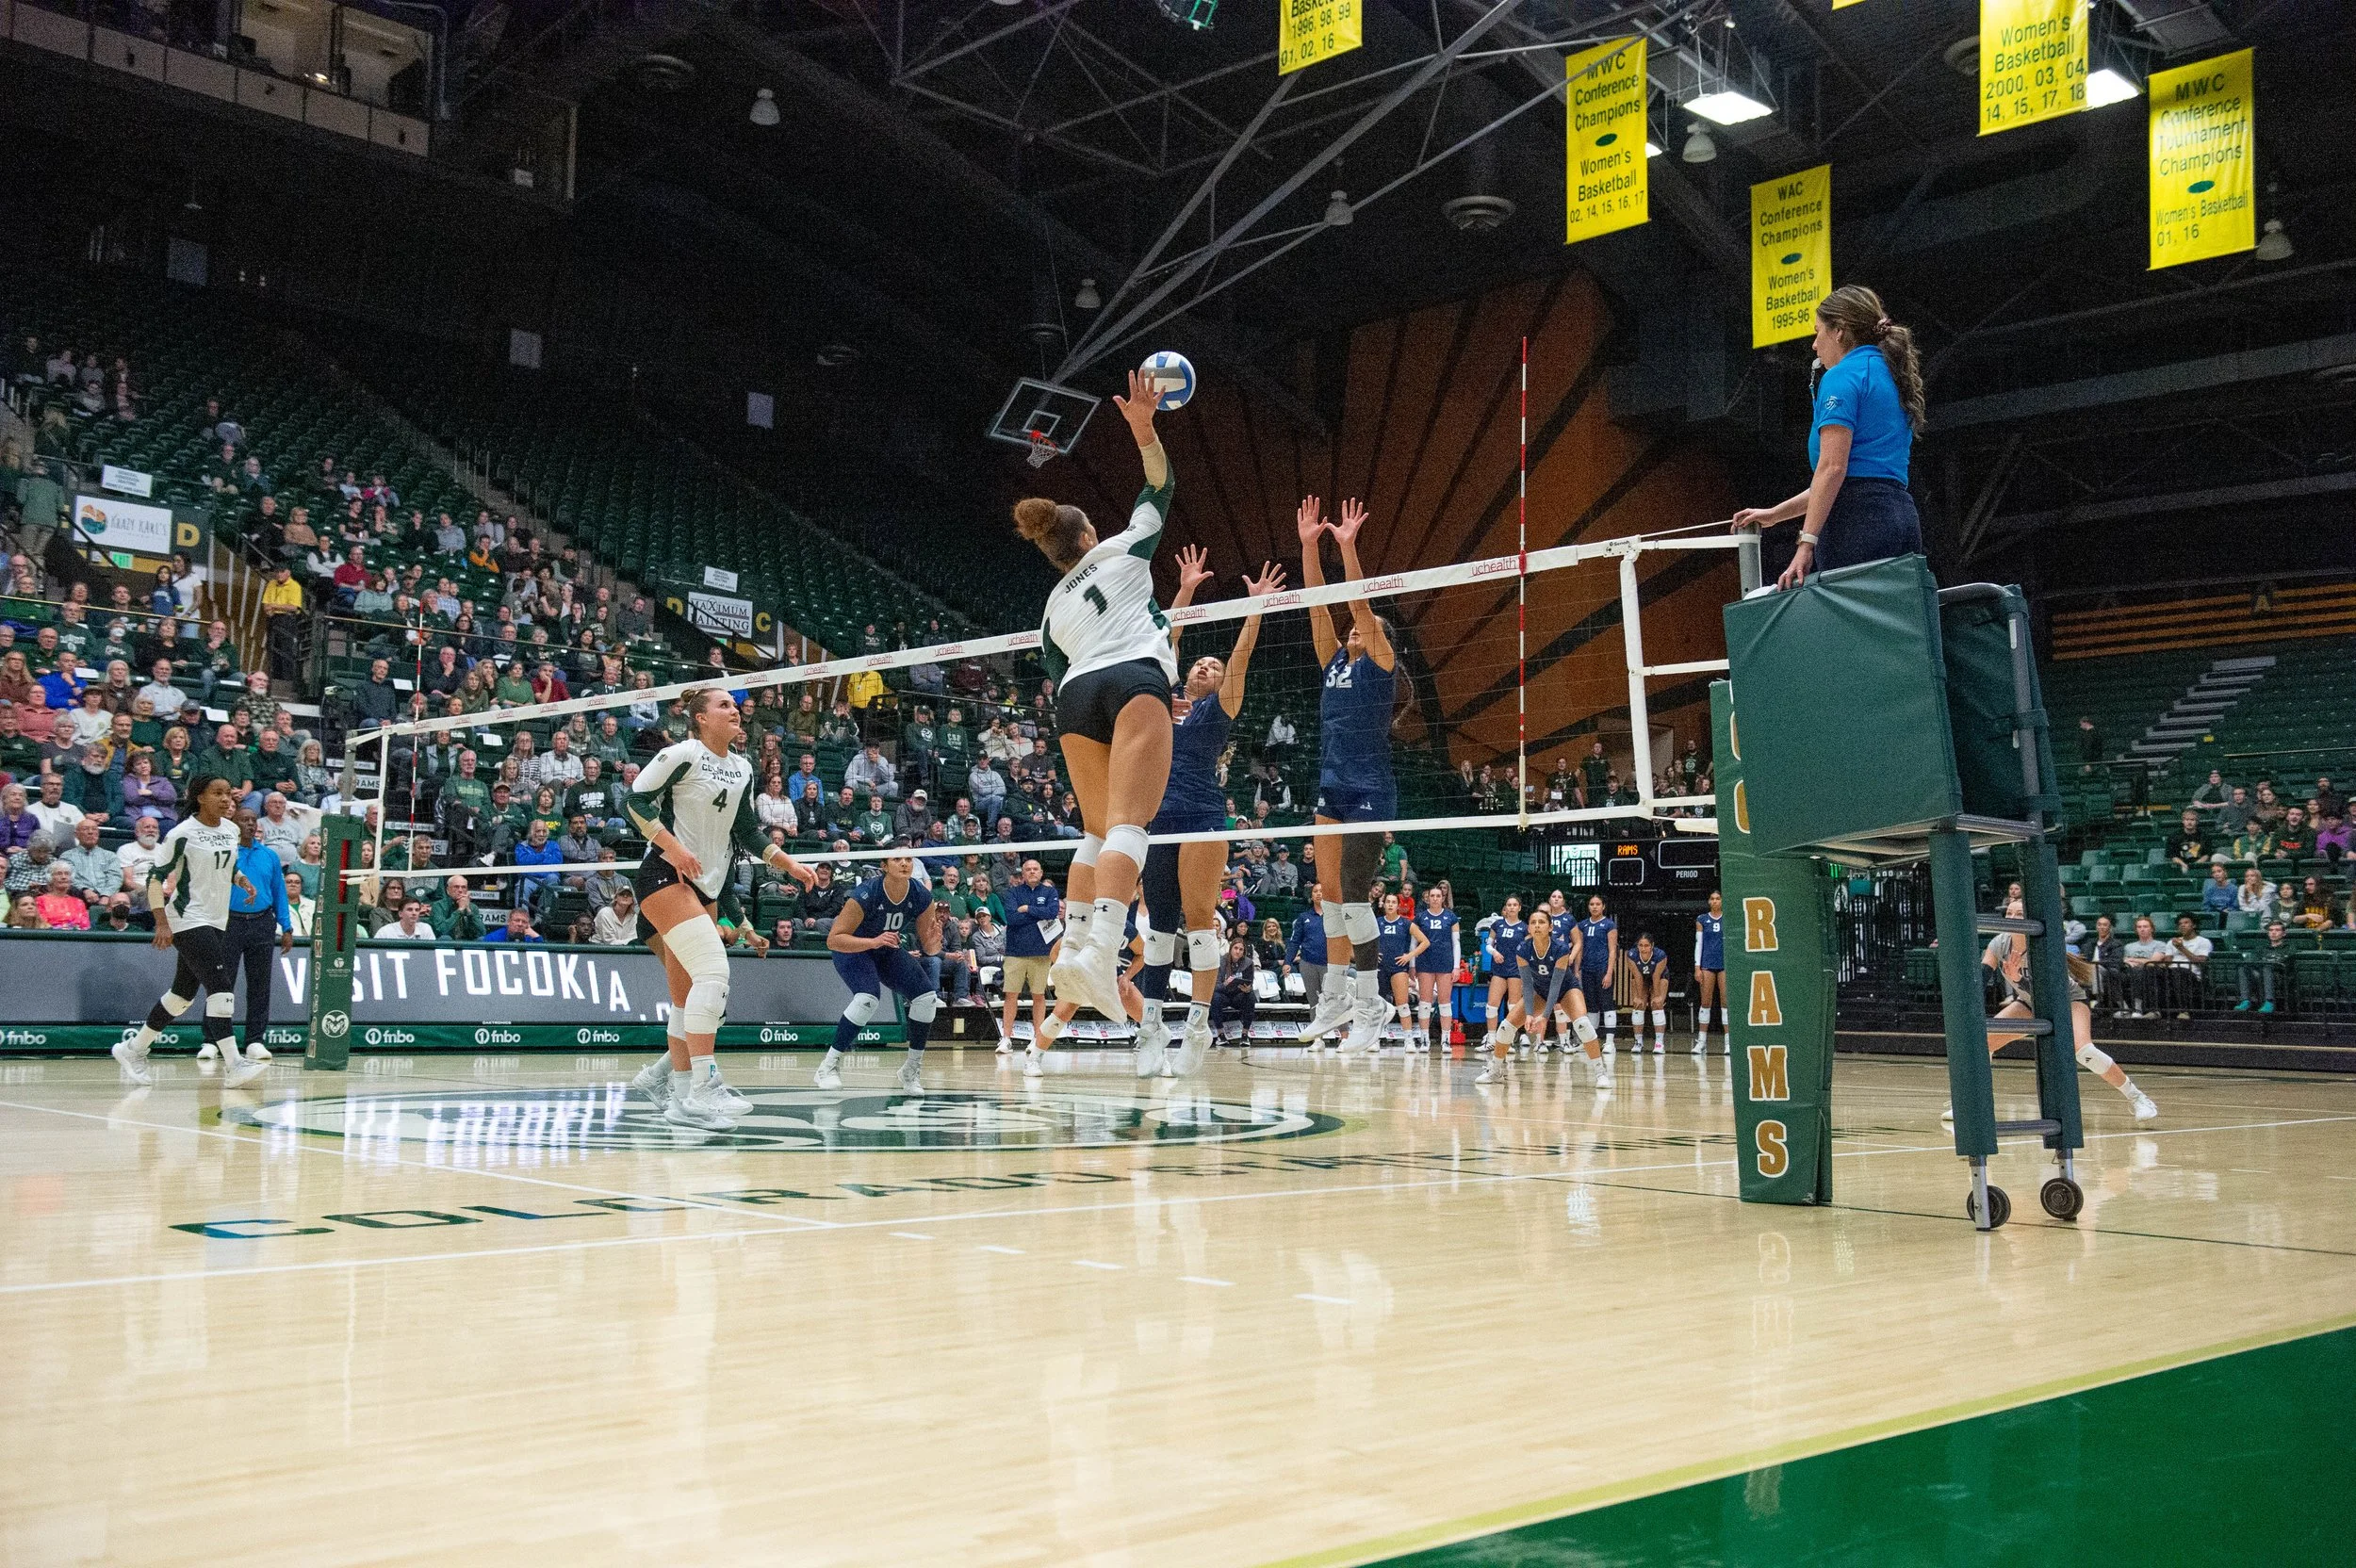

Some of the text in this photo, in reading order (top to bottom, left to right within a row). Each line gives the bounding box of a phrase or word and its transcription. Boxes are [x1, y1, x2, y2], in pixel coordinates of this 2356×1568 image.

[2001, 12, 2070, 47] Women's
[1322, 32, 1334, 52] 16
[1995, 34, 2074, 73] Basketball
[1575, 74, 1639, 106] Conference
[1986, 74, 2028, 100] 2000,
[2036, 66, 2058, 87] 03,
[2175, 73, 2225, 102] MWC
[1986, 82, 2085, 122] 14, 15, 17, 18
[2160, 95, 2241, 128] Conference
[1575, 99, 1641, 132] Champions
[2159, 118, 2248, 153] Tournament
[1580, 149, 1631, 176] Women's
[2160, 145, 2242, 176] Champions
[1579, 169, 1637, 202] Basketball
[1777, 181, 1803, 202] WAC
[1635, 190, 1644, 205] 17
[1760, 200, 1823, 227] Conference
[2155, 189, 2249, 227] Women's Basketball
[1761, 220, 1823, 247] Champions
[2184, 223, 2200, 240] 16
[1768, 268, 1815, 290] Women's
[1766, 286, 1820, 312] Basketball
[1772, 308, 1810, 331] 1995-96
[176, 522, 201, 547] D
[1472, 556, 1517, 576] uchealth
[1065, 564, 1098, 594] JONES
[1362, 576, 1405, 594] uchealth
[1083, 583, 1107, 617] 1
[1263, 593, 1301, 608] uchealth
[697, 614, 750, 631] AINTING
[756, 612, 772, 632] C
[1170, 606, 1207, 621] uchealth
[1008, 632, 1039, 646] uchealth
[867, 653, 894, 666] uchealth
[935, 643, 964, 656] uchealth
[1326, 664, 1352, 688] 32
[712, 788, 728, 813] 4
[214, 850, 232, 869] 17
[1617, 844, 1639, 856] RAMS
[883, 912, 904, 931] 10
[1384, 925, 1397, 934] 21
[1430, 920, 1442, 929] 12
[1587, 926, 1595, 937] 11
[1712, 923, 1720, 932] 9
[1501, 928, 1514, 939] 15
[280, 951, 411, 1004] VSIT
[1538, 964, 1548, 975] 8
[1643, 966, 1650, 974] 2
[591, 1030, 620, 1042] fnbo
[774, 1029, 798, 1042] fnbo
[1067, 1021, 1095, 1031] Pedersen
[8, 1030, 46, 1044] fnbo
[268, 1030, 302, 1044] fnbo
[384, 1030, 415, 1043] fnbo
[490, 1030, 521, 1043] fnbo
[1742, 896, 1790, 1179] RAMS
